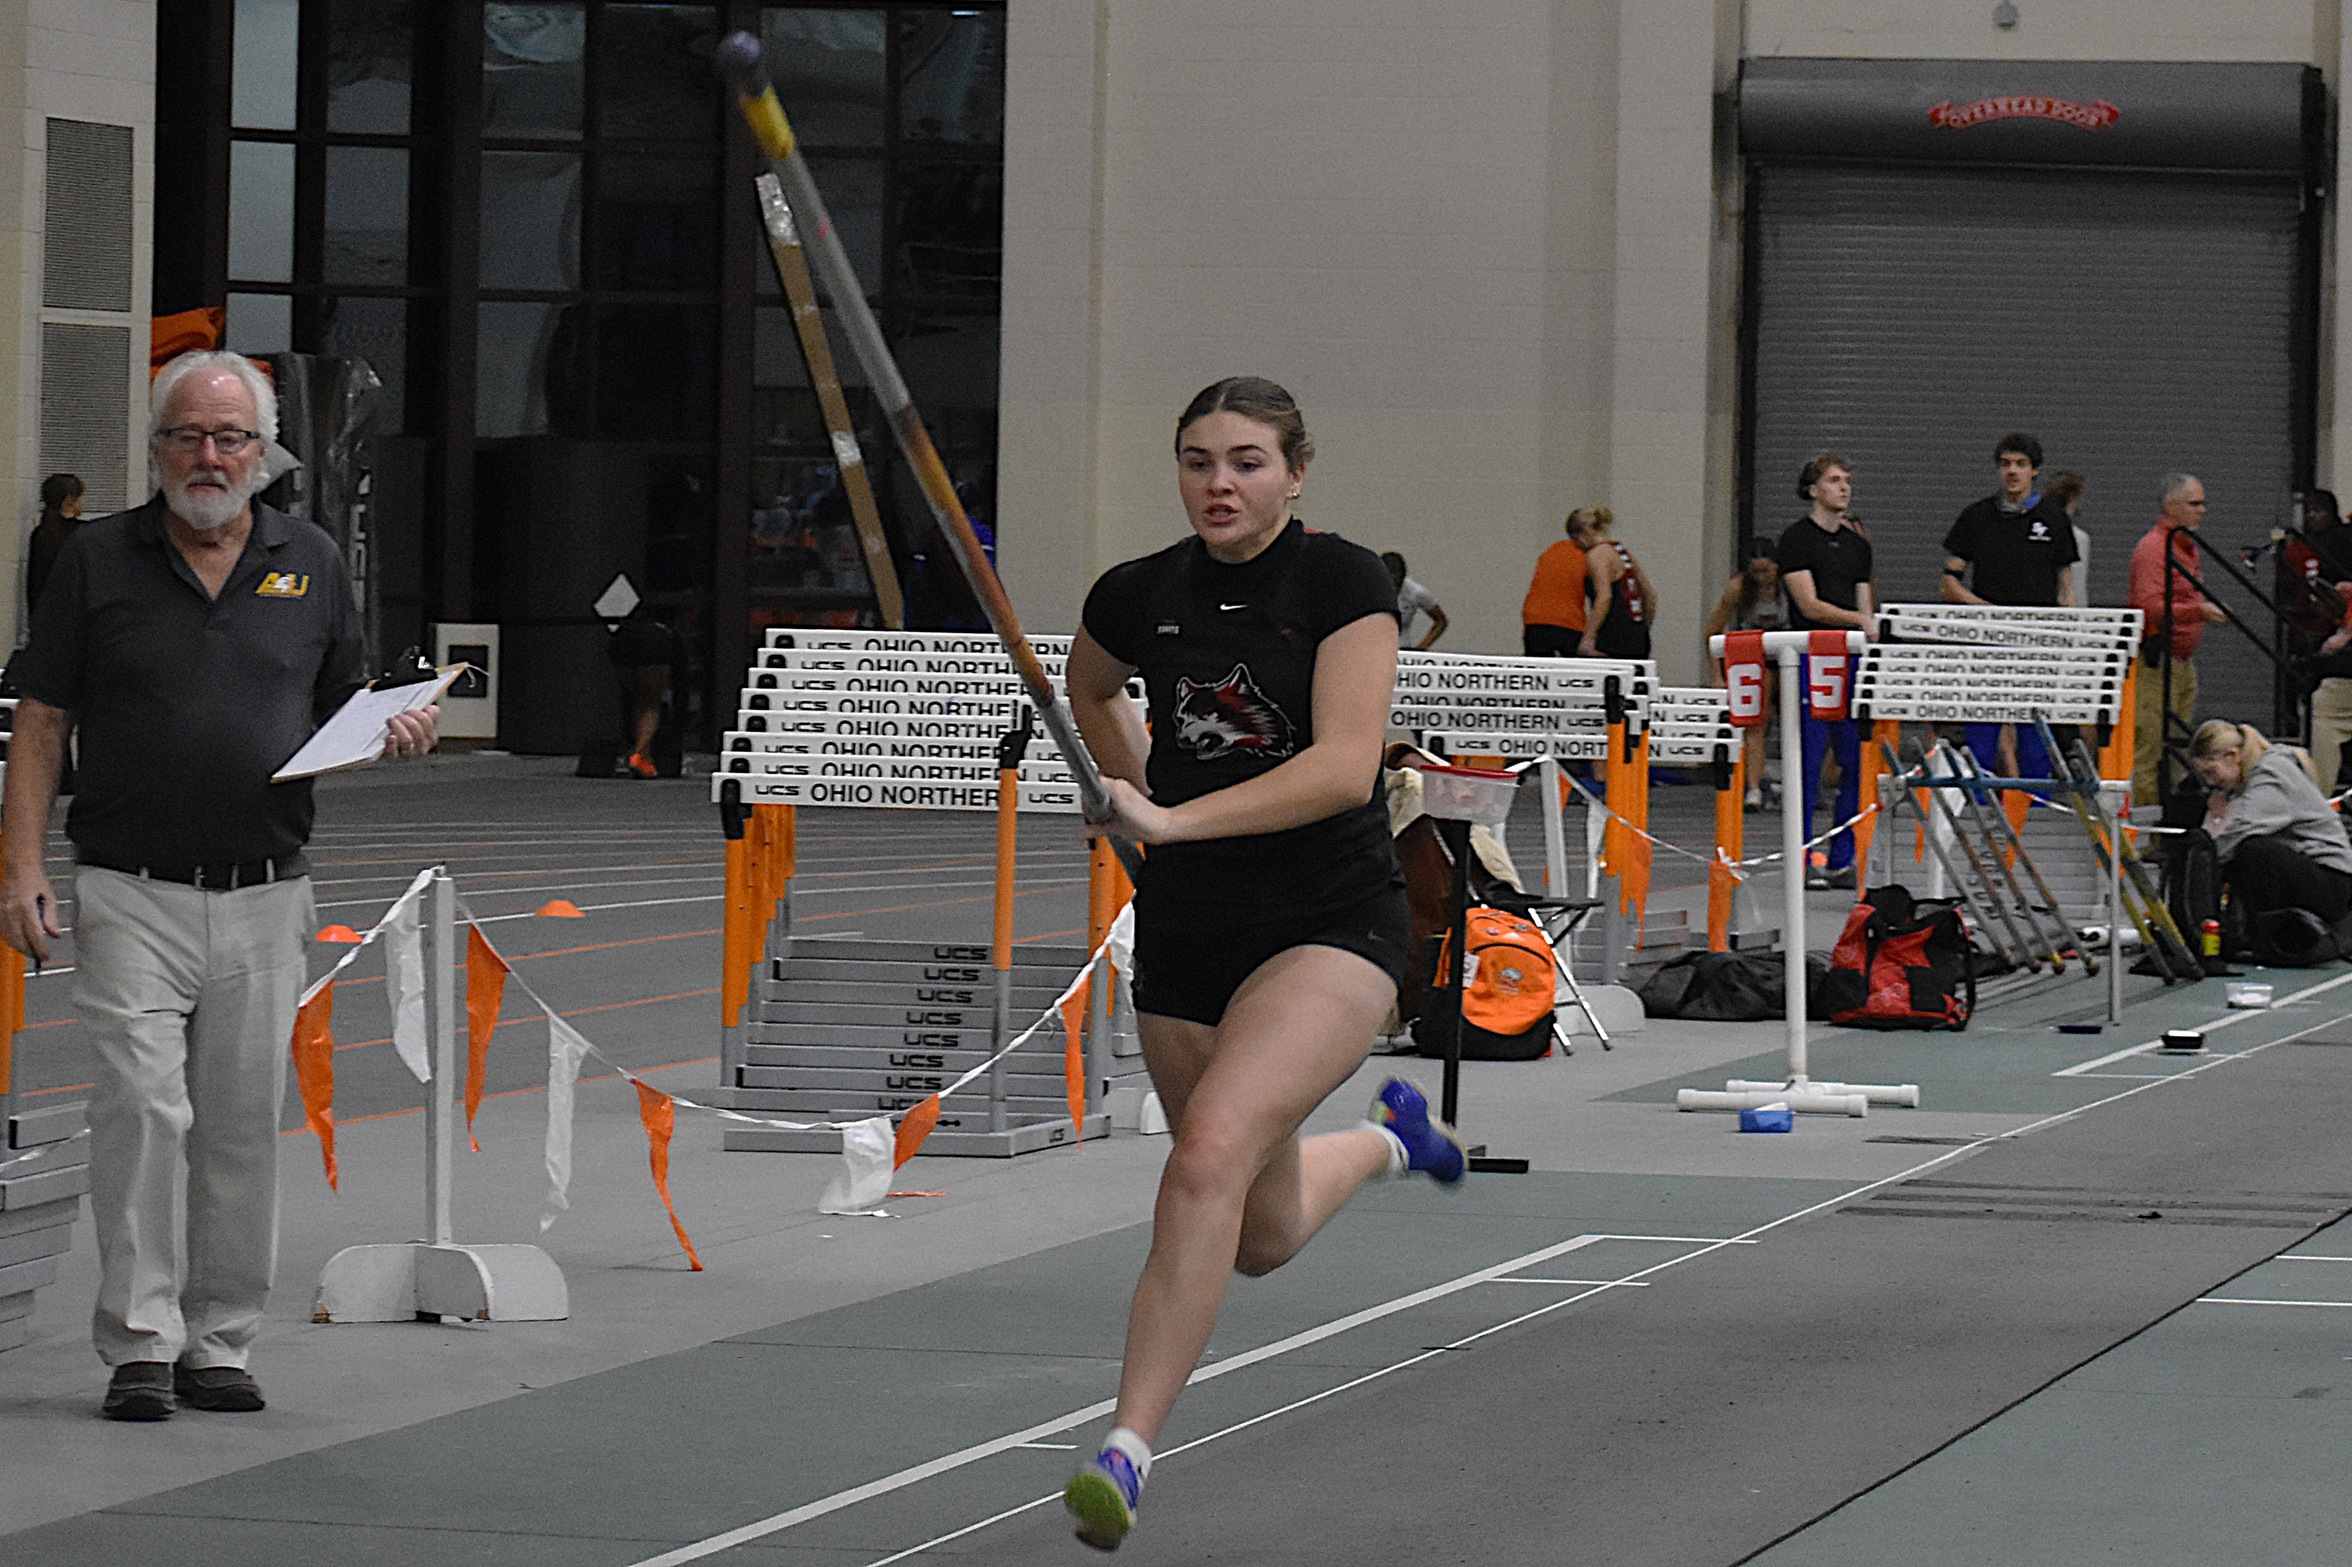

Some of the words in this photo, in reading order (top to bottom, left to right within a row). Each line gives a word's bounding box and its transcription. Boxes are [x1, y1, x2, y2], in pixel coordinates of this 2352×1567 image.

[1938, 625, 1979, 639] OHIO
[1983, 630, 2073, 648] NORTHERN
[865, 638, 925, 651] OHIO
[934, 640, 1068, 655] NORTRN
[801, 660, 846, 670] UCS
[857, 658, 918, 672] OHIO
[926, 660, 1062, 676] NORTHN
[791, 680, 836, 691] UCS
[847, 677, 908, 692] OHIO
[916, 680, 1055, 696] NORTHE
[1397, 672, 1432, 688] HIO
[1438, 673, 1549, 691] NORTHERN
[1557, 679, 1594, 688] UCS
[1728, 663, 1762, 717] 6
[1809, 656, 1844, 708] 5
[783, 701, 828, 711] UCS
[838, 698, 900, 714] OHIO
[1916, 704, 1958, 718] OHIO
[1962, 706, 2051, 721] NORTHEN
[1390, 711, 1441, 726] OHIO
[1447, 712, 1559, 729] NORTHERN
[1566, 718, 1604, 727] UCS
[781, 721, 826, 733] UCS
[836, 719, 898, 735] OHIO
[907, 722, 1044, 740] NORTHEN
[764, 744, 809, 754] UCS
[821, 741, 882, 755] OHIO
[890, 743, 1001, 760] NORTHE
[1499, 739, 1548, 754] OHIO
[765, 764, 809, 775] UCS
[821, 762, 882, 777] OHIO
[755, 784, 800, 796] UCS
[811, 783, 873, 803] OHIO
[881, 785, 999, 807] NORTHER
[1028, 793, 1075, 804] UCS
[934, 946, 988, 961] UCS
[924, 967, 980, 982] UCS
[916, 988, 974, 1004] UCS
[906, 1010, 962, 1026] UCS
[903, 1033, 959, 1047] UCS
[889, 1053, 944, 1068] UCS
[886, 1075, 943, 1090] UCS
[878, 1097, 925, 1111] UC
